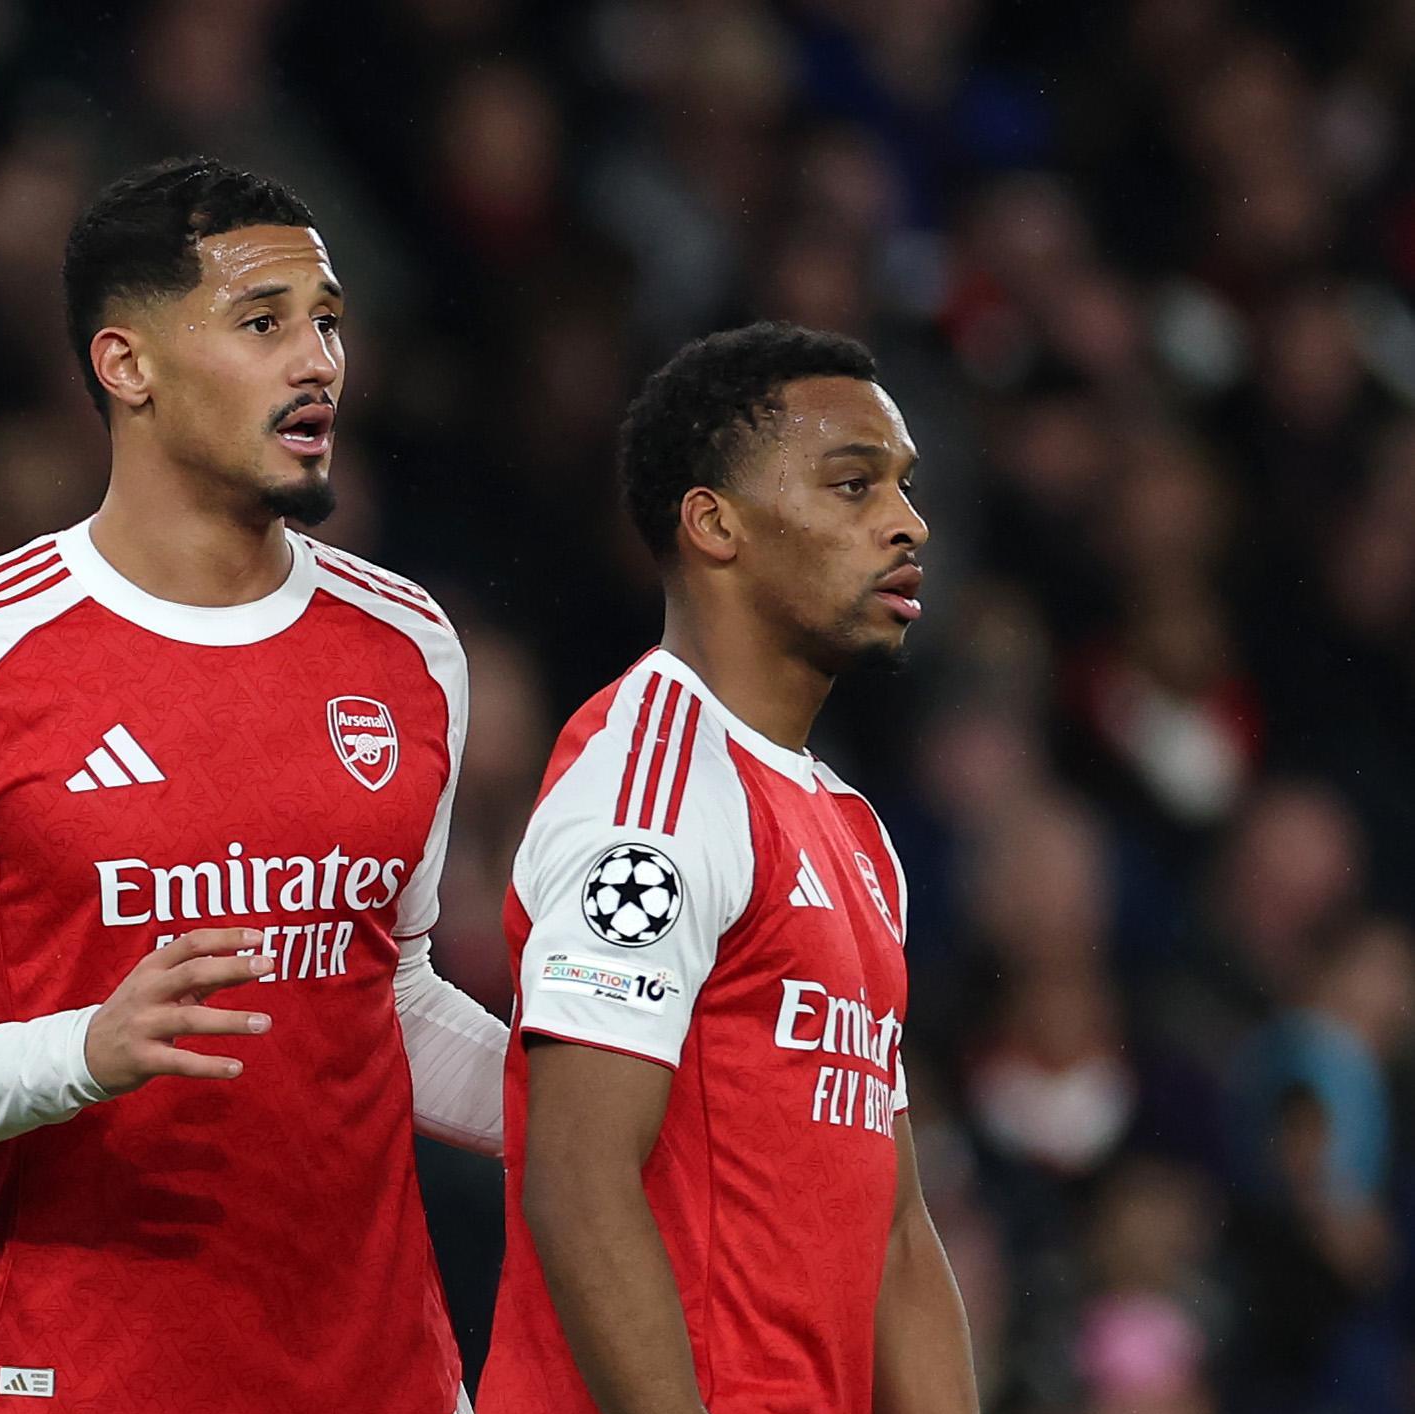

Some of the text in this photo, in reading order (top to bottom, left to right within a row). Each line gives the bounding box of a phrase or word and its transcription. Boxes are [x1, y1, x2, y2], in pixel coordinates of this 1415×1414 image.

[338, 711, 387, 728] Arsenal
[94, 842, 405, 926] Emirates
[237, 920, 354, 983] ETTER
[543, 966, 631, 990] FOUNDATION
[812, 1066, 859, 1126] FLY
